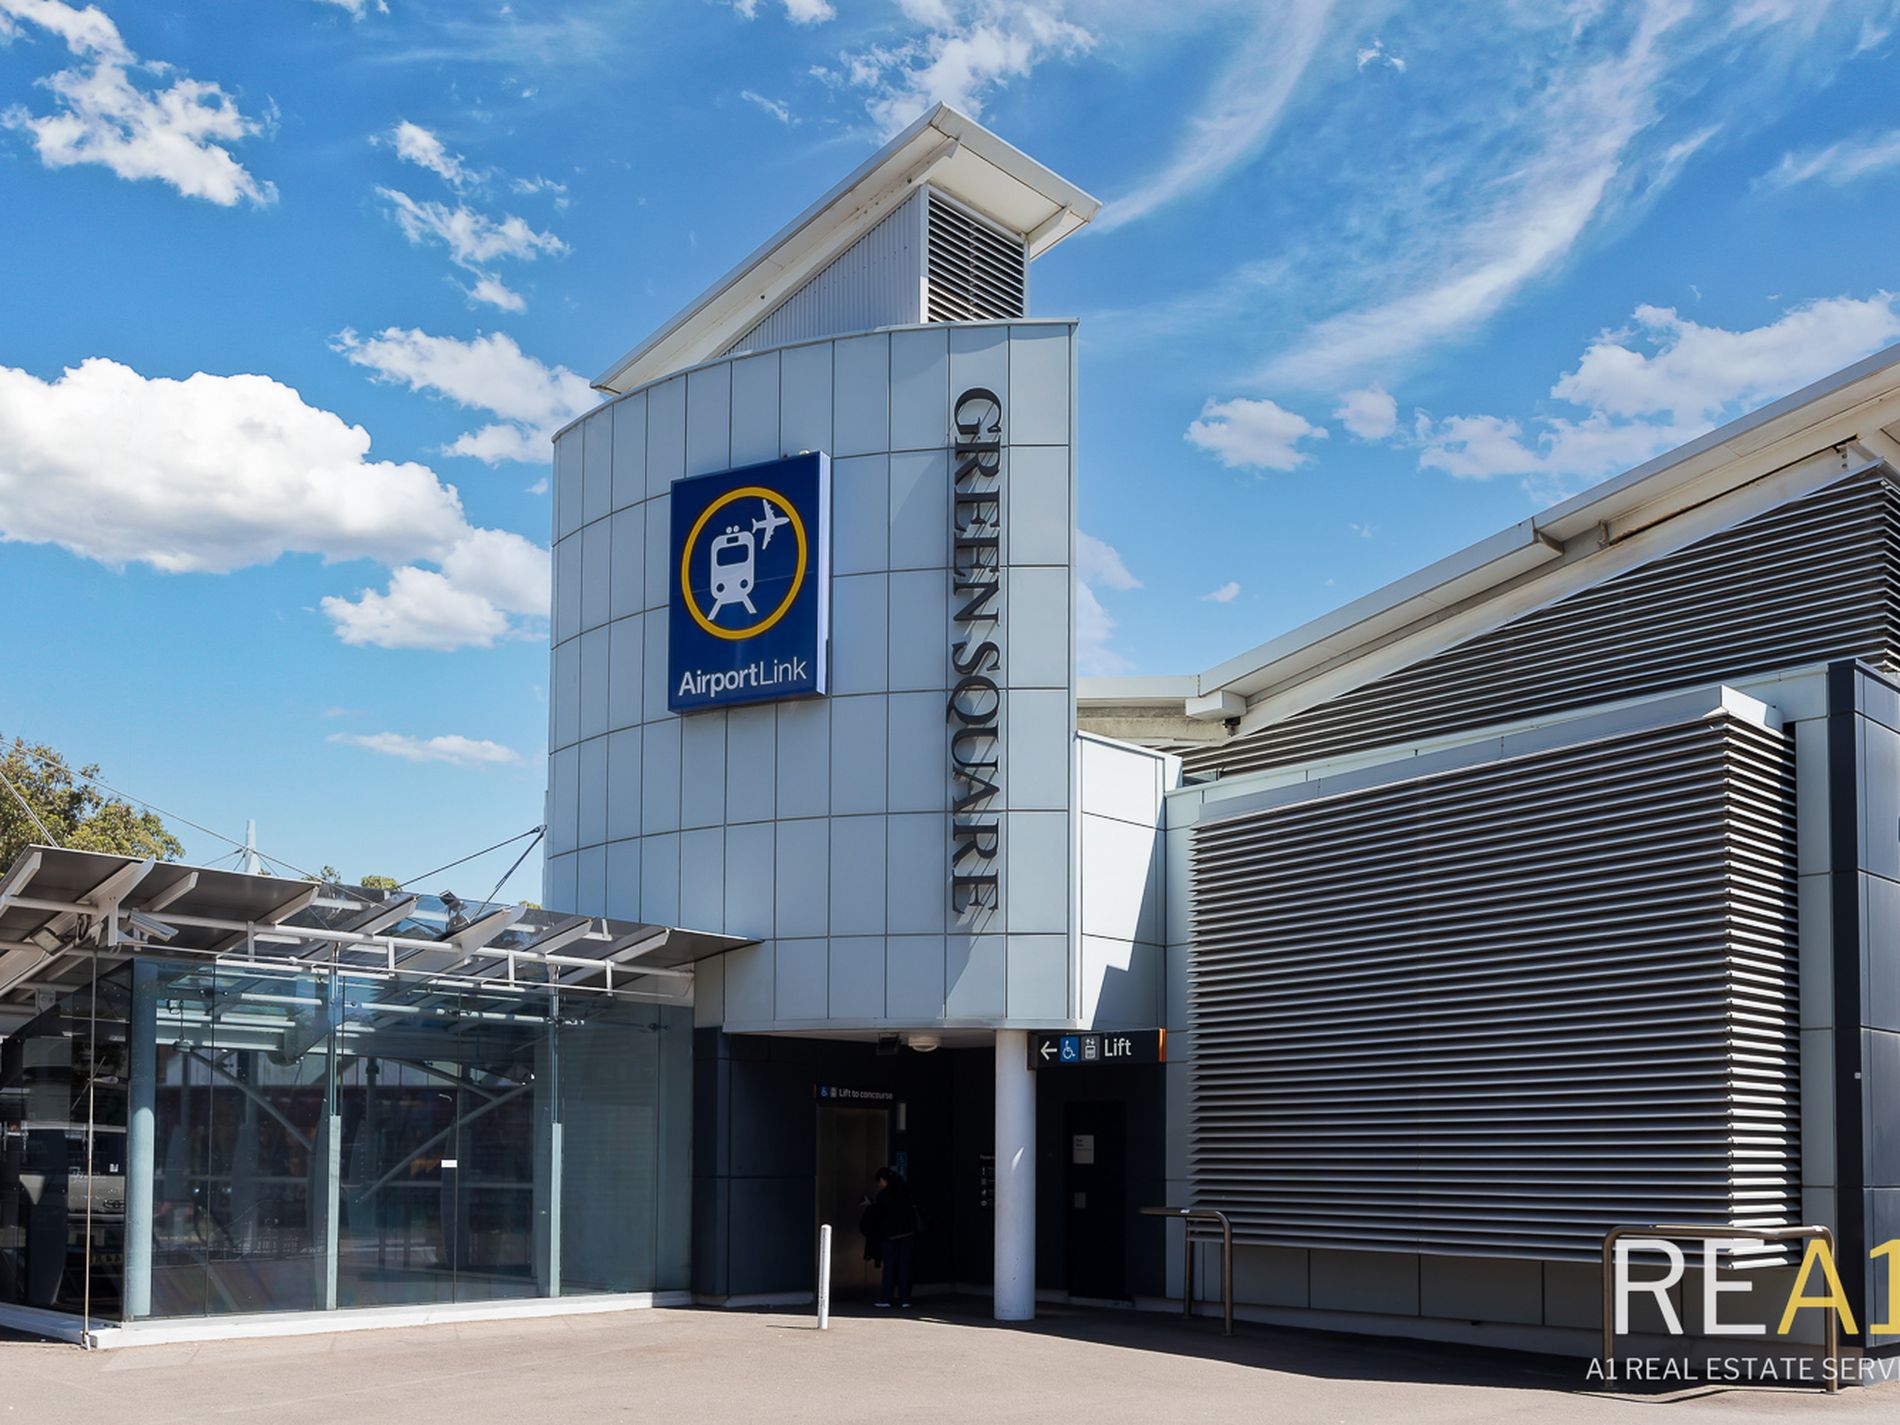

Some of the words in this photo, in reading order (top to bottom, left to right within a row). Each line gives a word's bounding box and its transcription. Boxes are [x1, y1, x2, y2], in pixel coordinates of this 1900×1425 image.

[954, 387, 1001, 627] GREEN
[678, 656, 807, 698] AirportLink
[946, 641, 1000, 914] SQUARE
[1104, 1038, 1132, 1057] Lift
[839, 1088, 851, 1098] Lift
[852, 1089, 860, 1098] to
[860, 1091, 893, 1100] concourse
